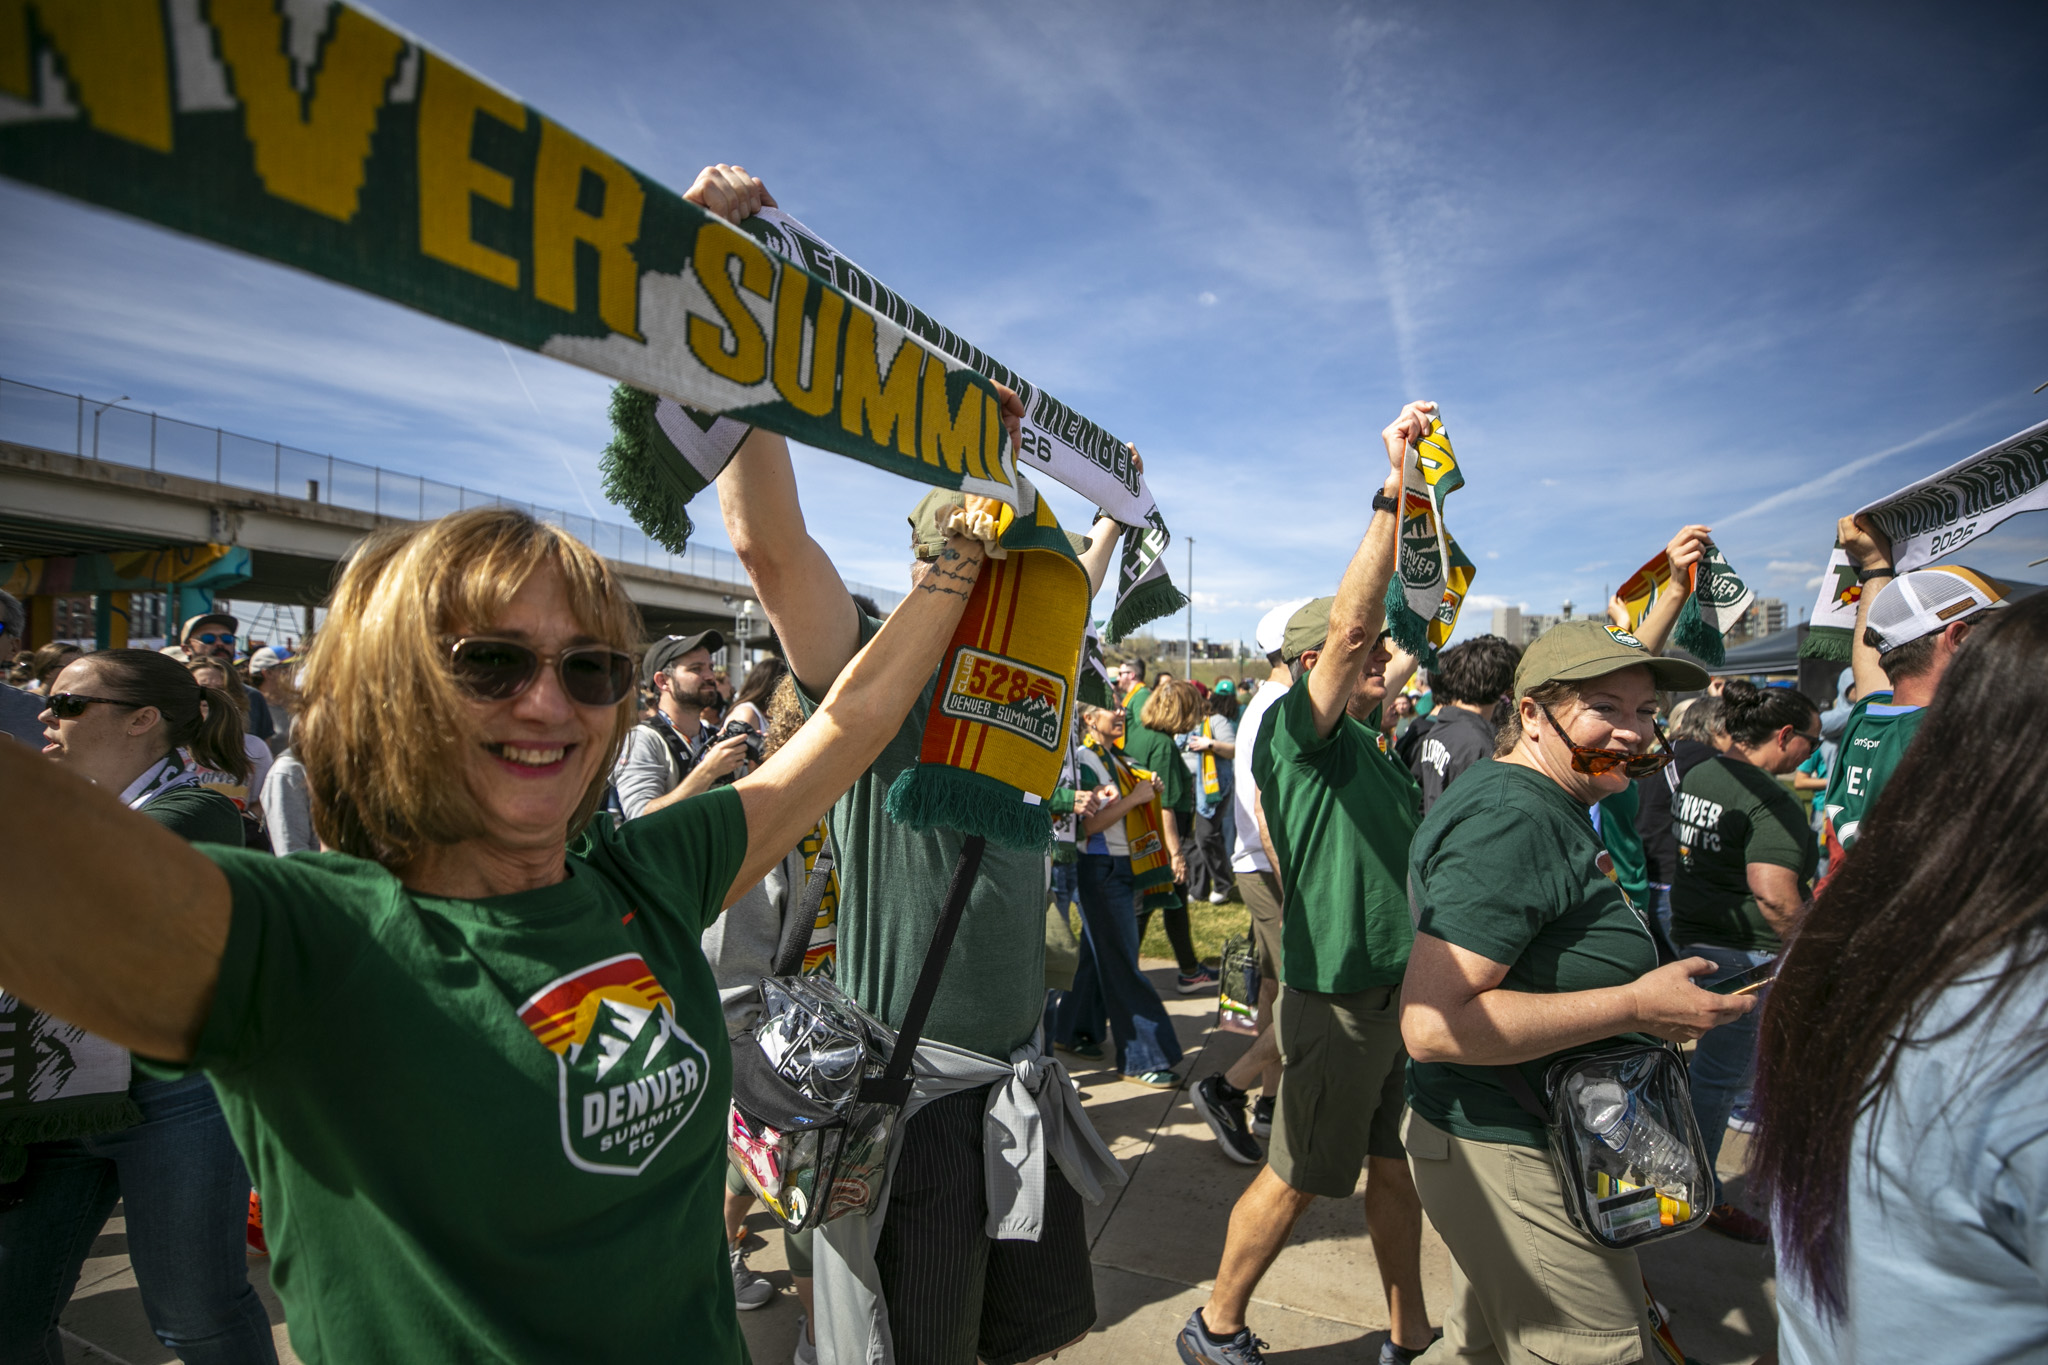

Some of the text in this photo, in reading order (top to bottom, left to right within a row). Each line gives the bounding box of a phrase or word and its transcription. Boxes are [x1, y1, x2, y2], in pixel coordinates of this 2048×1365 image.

[685, 221, 1014, 487] SUMMI
[1020, 427, 1053, 463] 26
[1032, 387, 1140, 498] MEMBER
[1401, 542, 1436, 577] ENVER
[1930, 522, 1977, 556] 2026
[1697, 565, 1739, 598] ENVER
[957, 655, 975, 693] CLUB
[968, 658, 1029, 704] 528
[950, 694, 1055, 741] DENVER SUMMIT FC
[582, 1056, 699, 1139] DENVER
[600, 1101, 685, 1152] SUMMIT
[628, 1132, 656, 1156] FC
